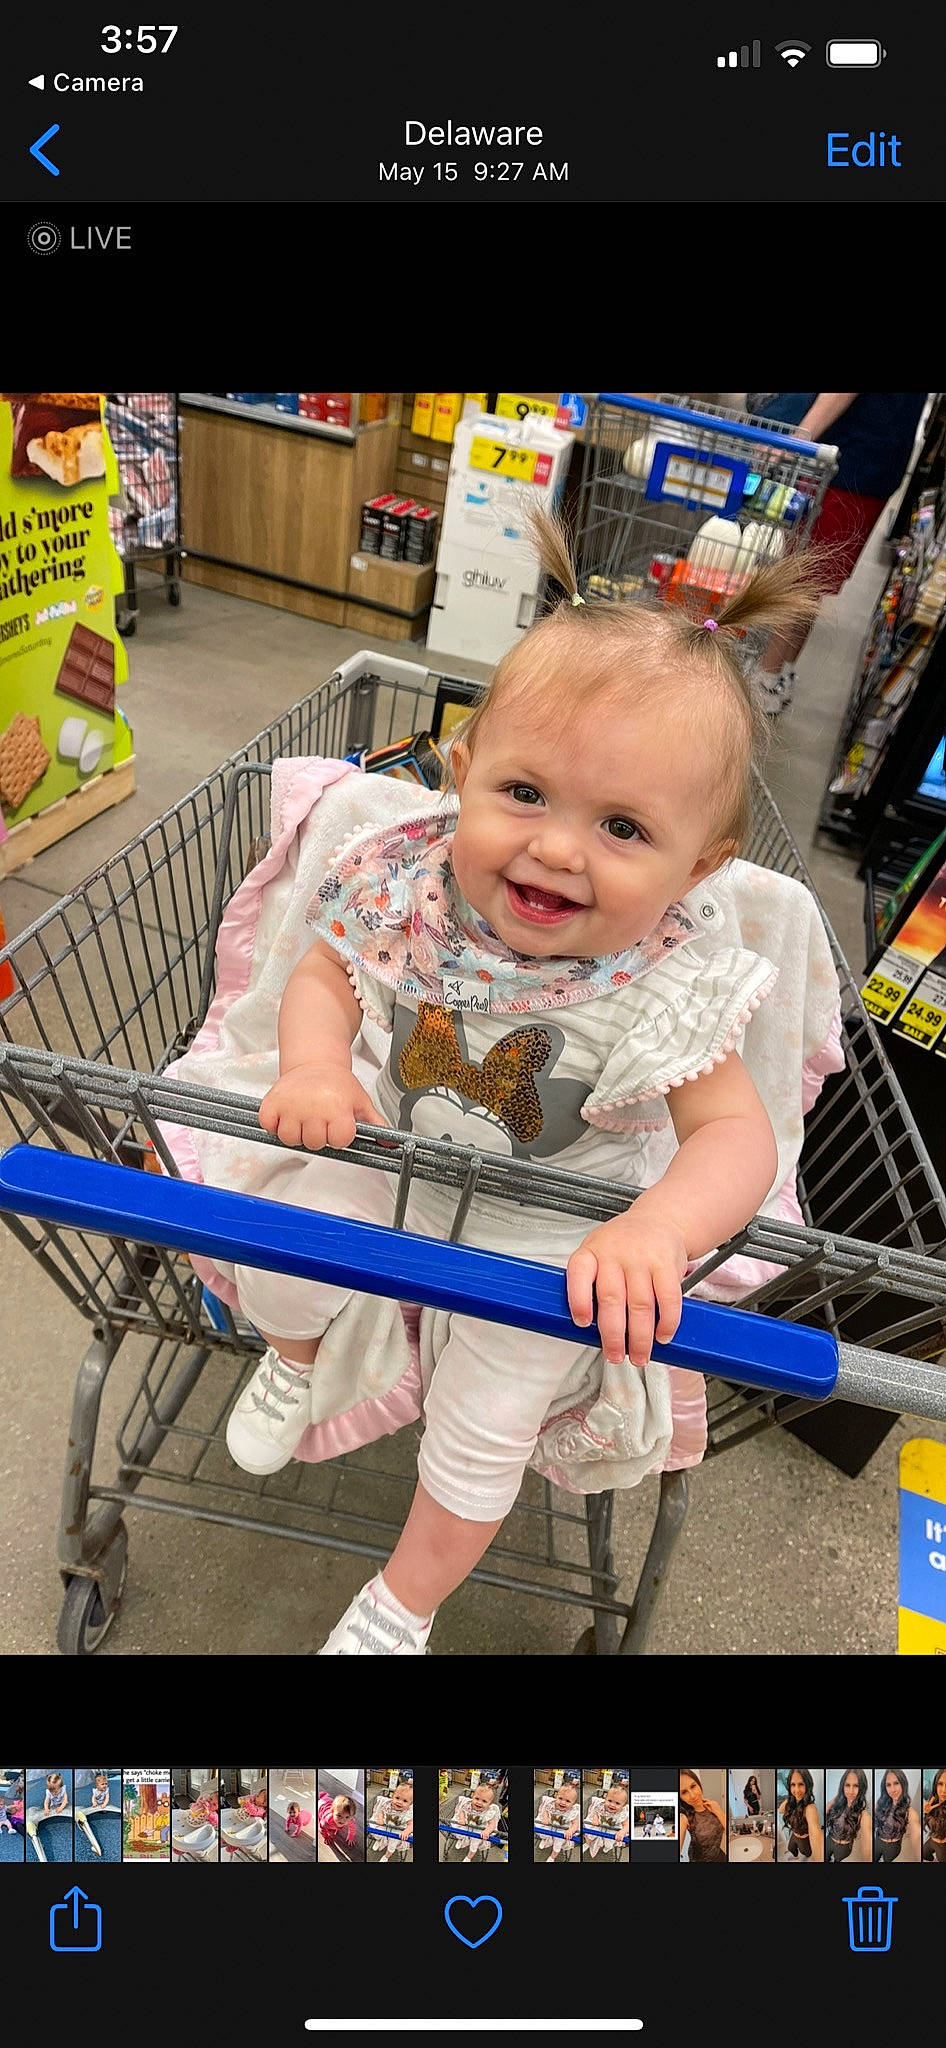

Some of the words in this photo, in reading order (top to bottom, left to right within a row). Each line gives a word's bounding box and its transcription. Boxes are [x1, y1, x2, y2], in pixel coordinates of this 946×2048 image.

[22, 501, 93, 534] s'more
[16, 542, 37, 565] to
[41, 529, 91, 563] your
[867, 978, 901, 1002] 22.99
[907, 1002, 942, 1027] 24.99
